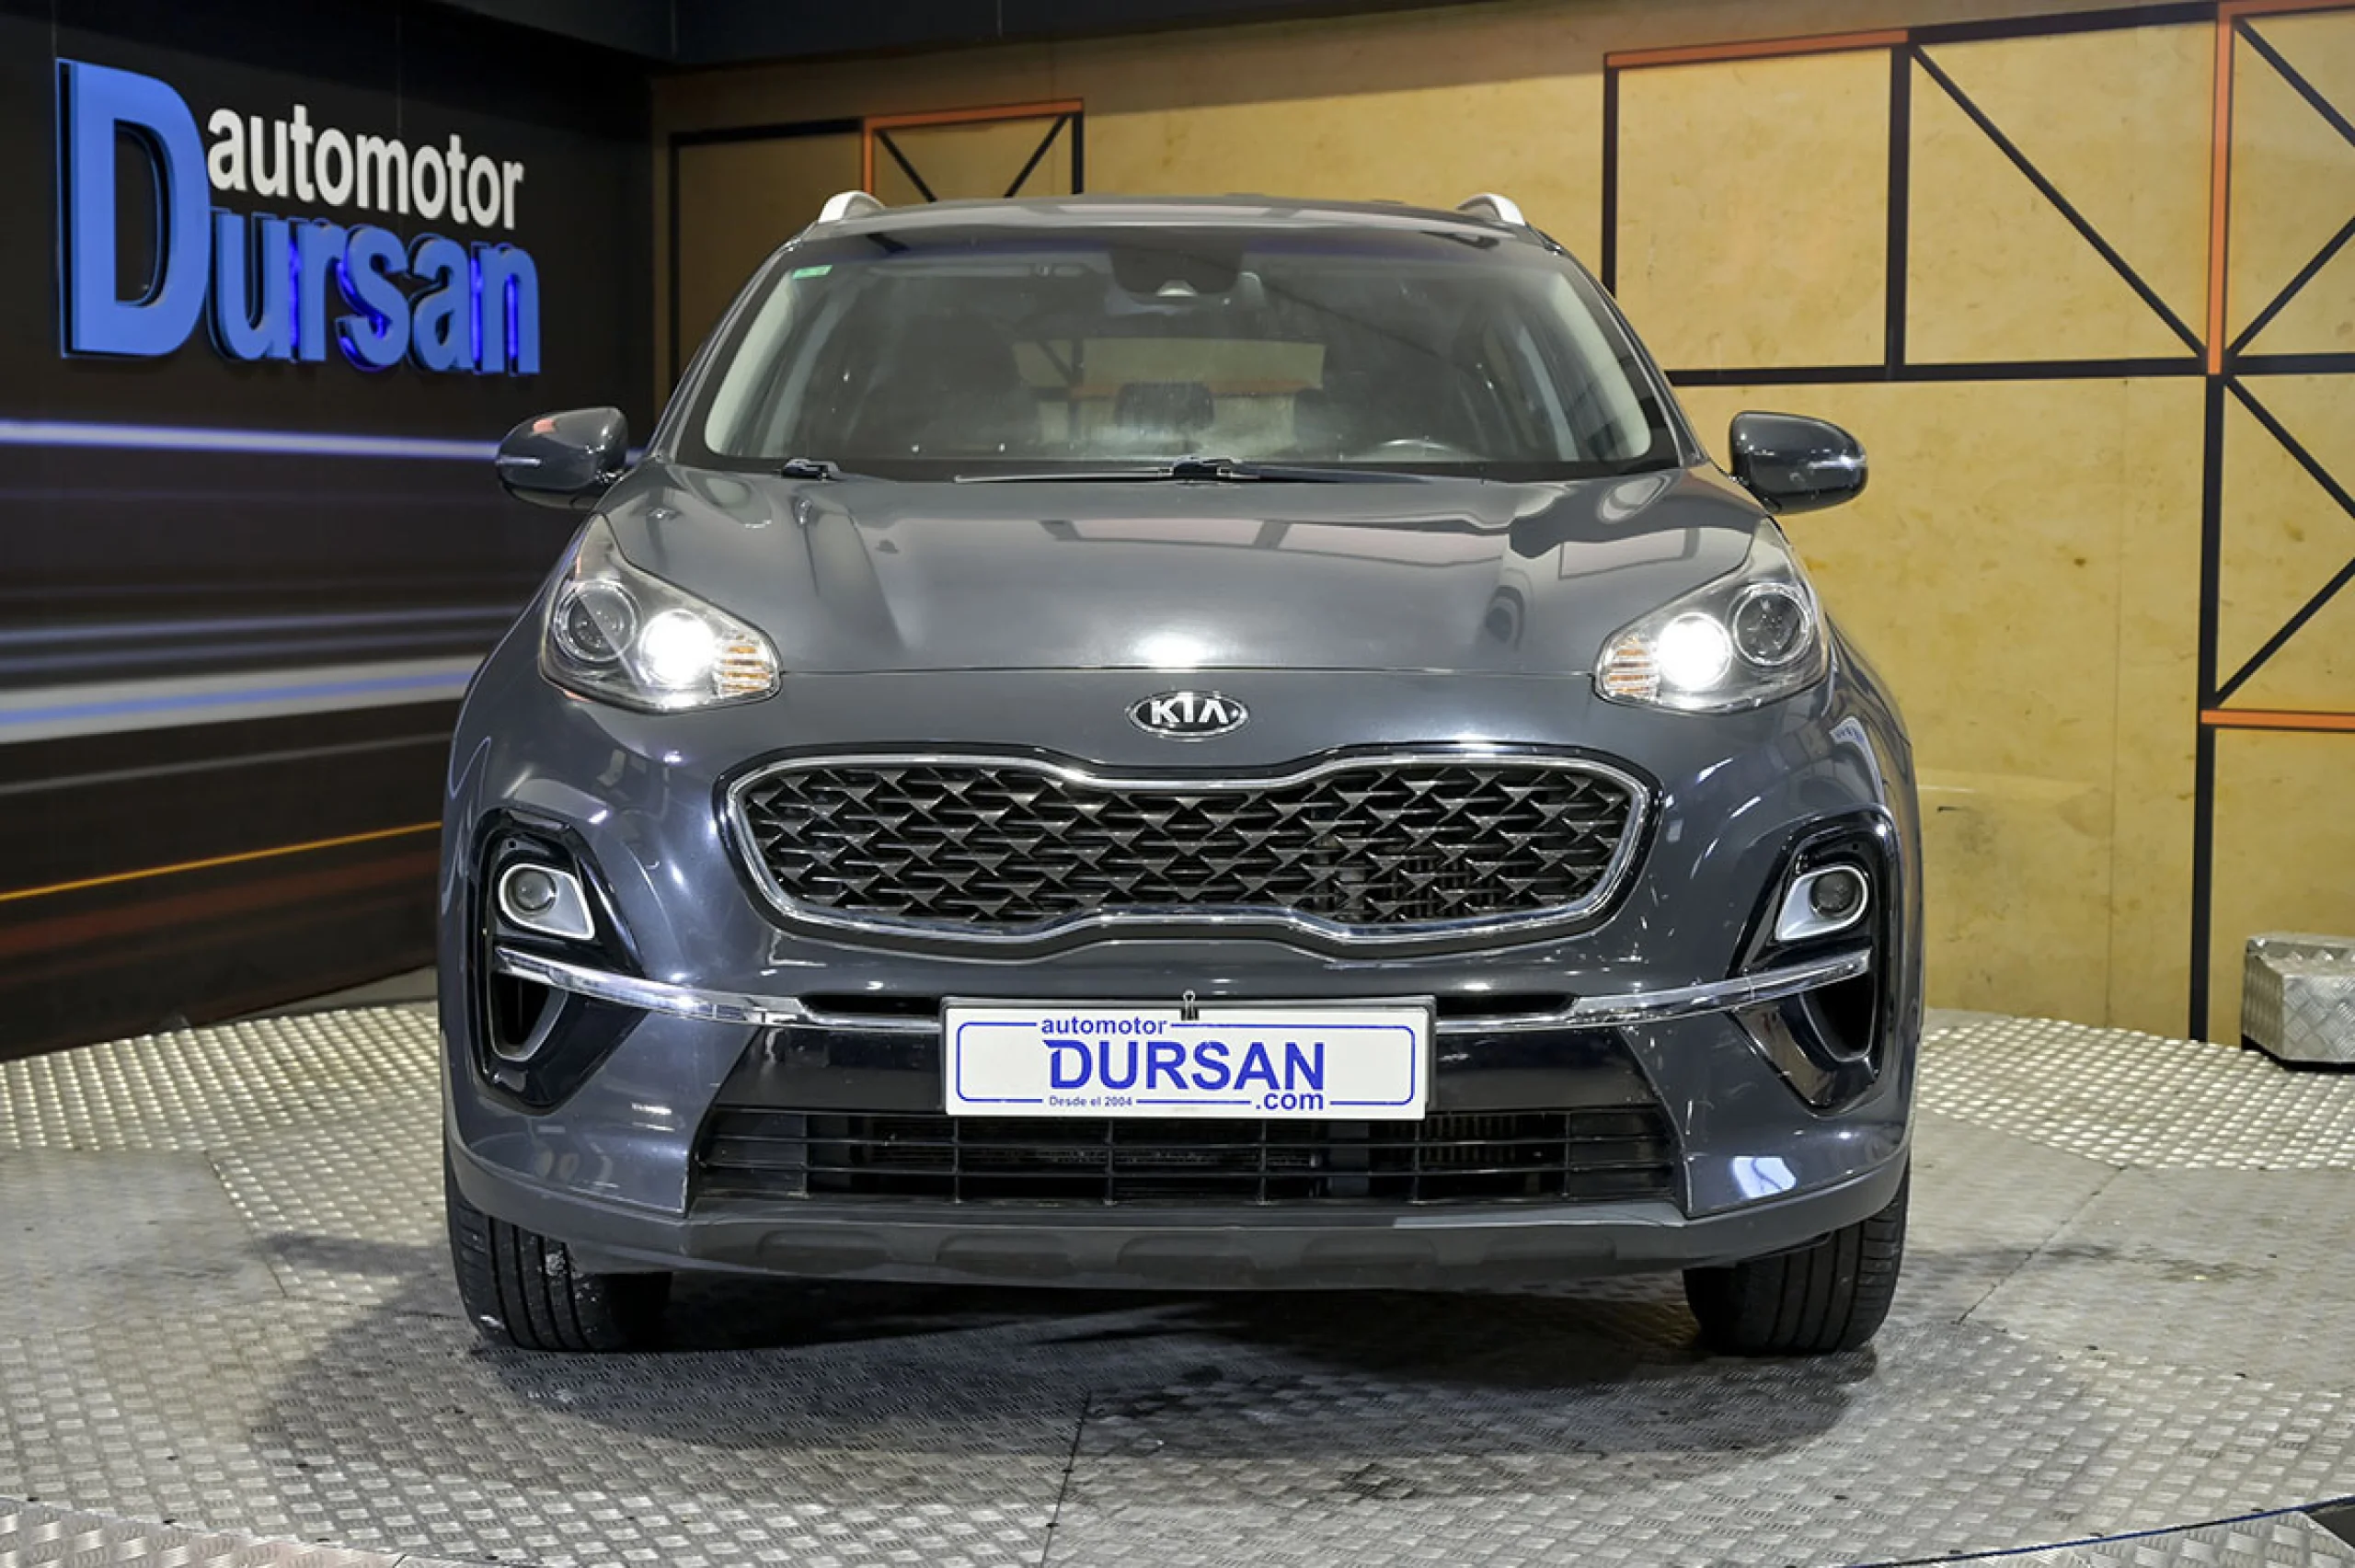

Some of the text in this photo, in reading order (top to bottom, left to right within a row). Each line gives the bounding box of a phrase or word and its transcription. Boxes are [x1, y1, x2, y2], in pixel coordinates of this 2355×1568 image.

[207, 104, 524, 229] automotor
[55, 56, 541, 375] Dursan
[1151, 692, 1229, 725] KIA
[1041, 1015, 1167, 1035] automotor
[1041, 1039, 1325, 1090] DURSAN
[1049, 1095, 1132, 1106] Desde el 2004
[1255, 1092, 1325, 1111] .com
